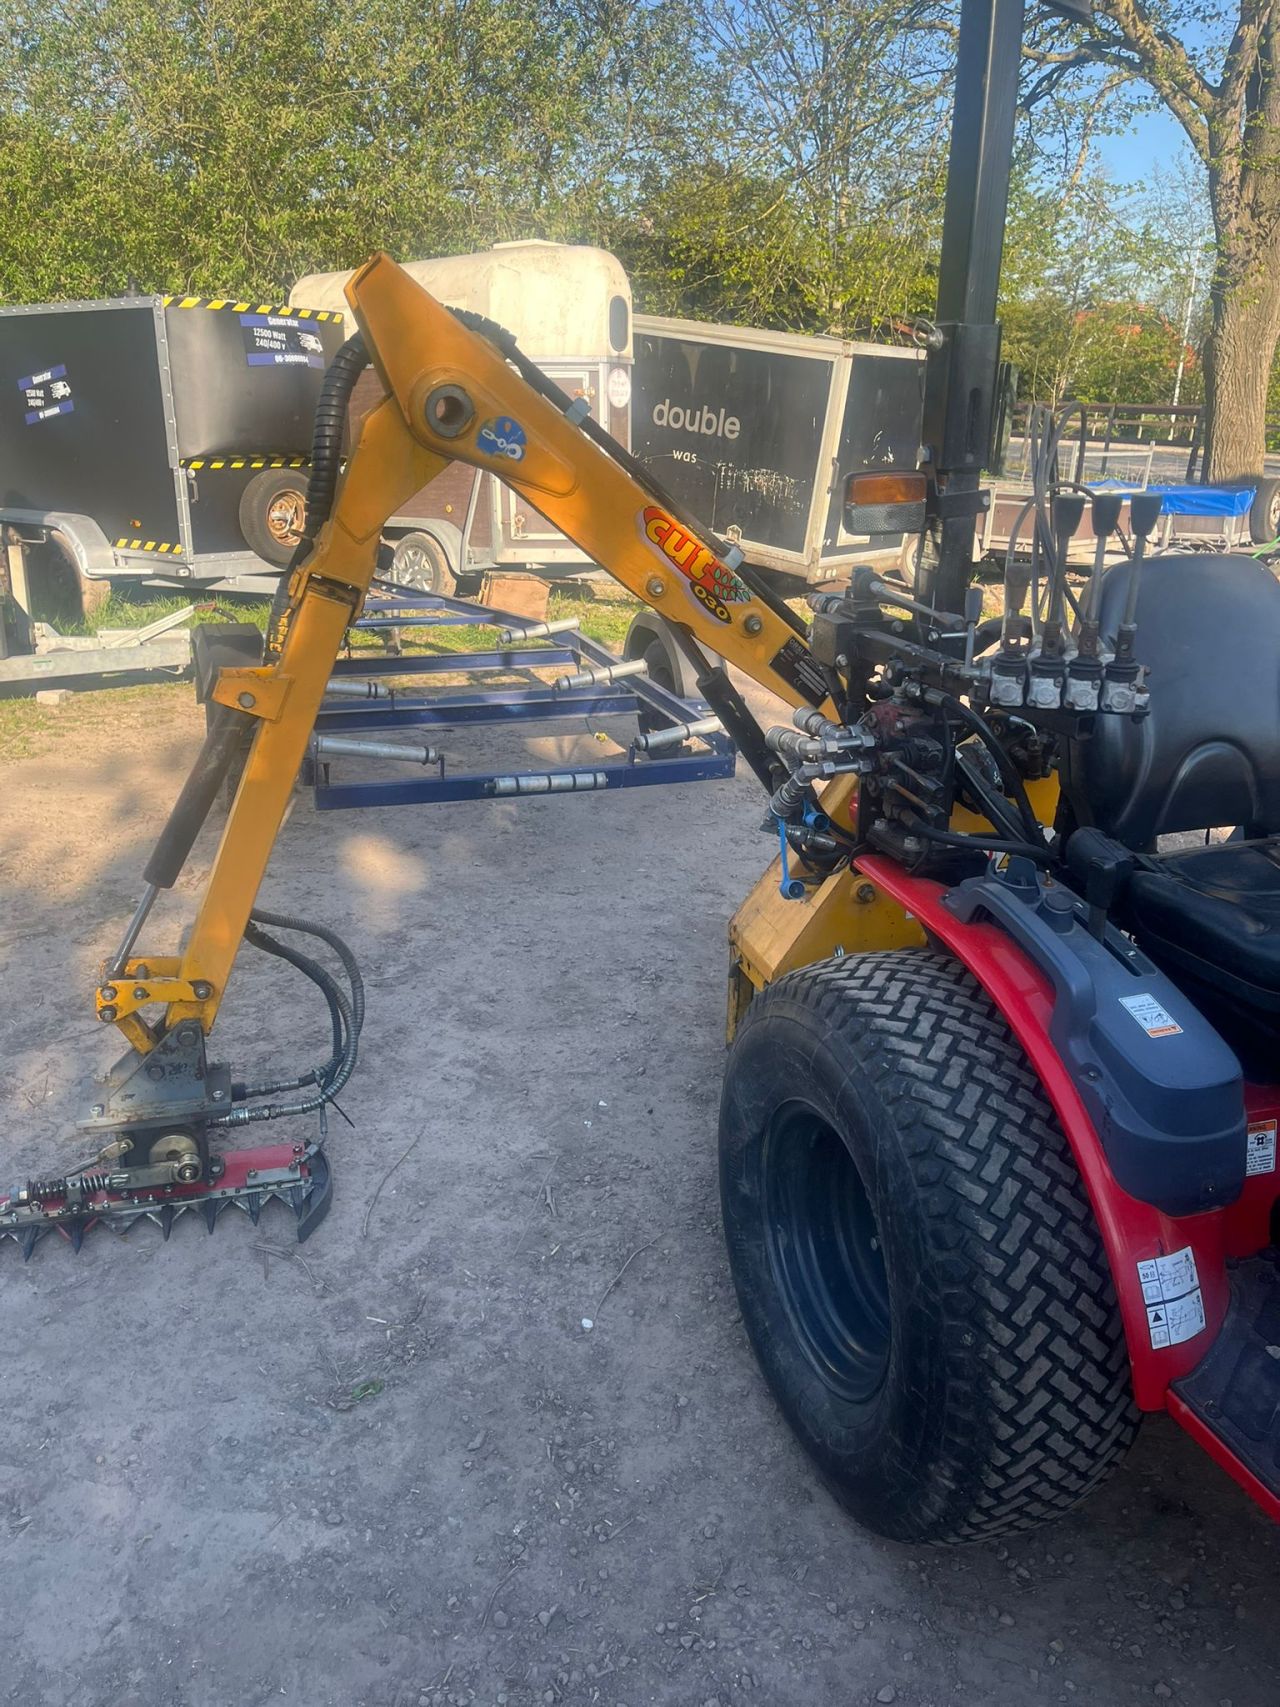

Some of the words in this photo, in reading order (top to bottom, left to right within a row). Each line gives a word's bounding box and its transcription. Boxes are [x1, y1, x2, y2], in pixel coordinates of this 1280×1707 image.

[253, 328, 272, 338] 12500
[255, 338, 281, 349] 240/400
[652, 398, 741, 440] double
[672, 449, 697, 463] was
